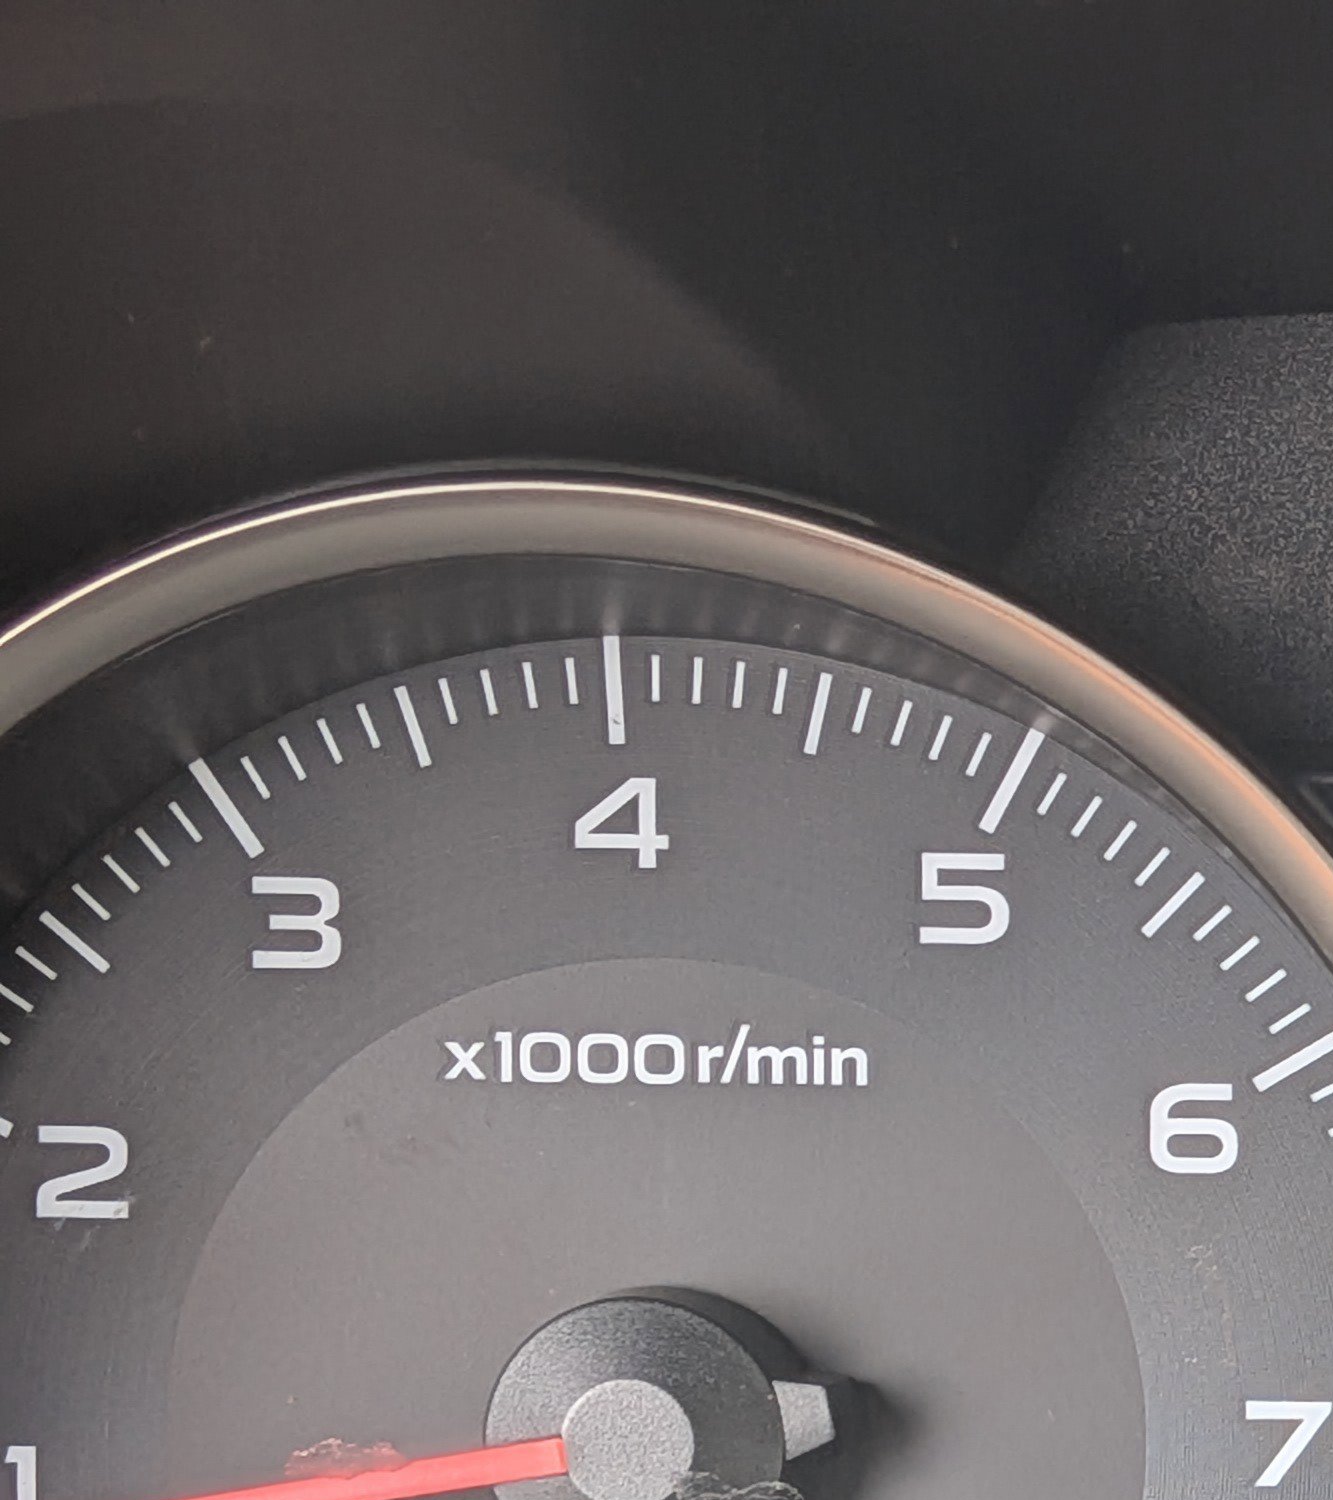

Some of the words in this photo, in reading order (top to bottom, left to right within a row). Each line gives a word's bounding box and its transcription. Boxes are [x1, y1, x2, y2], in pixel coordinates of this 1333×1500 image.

[575, 778, 669, 868] 4
[252, 877, 341, 968] 3
[920, 853, 1009, 944] 5
[37, 1126, 128, 1218] 2
[1150, 1083, 1238, 1173] 6
[1246, 1401, 1332, 1486] 7
